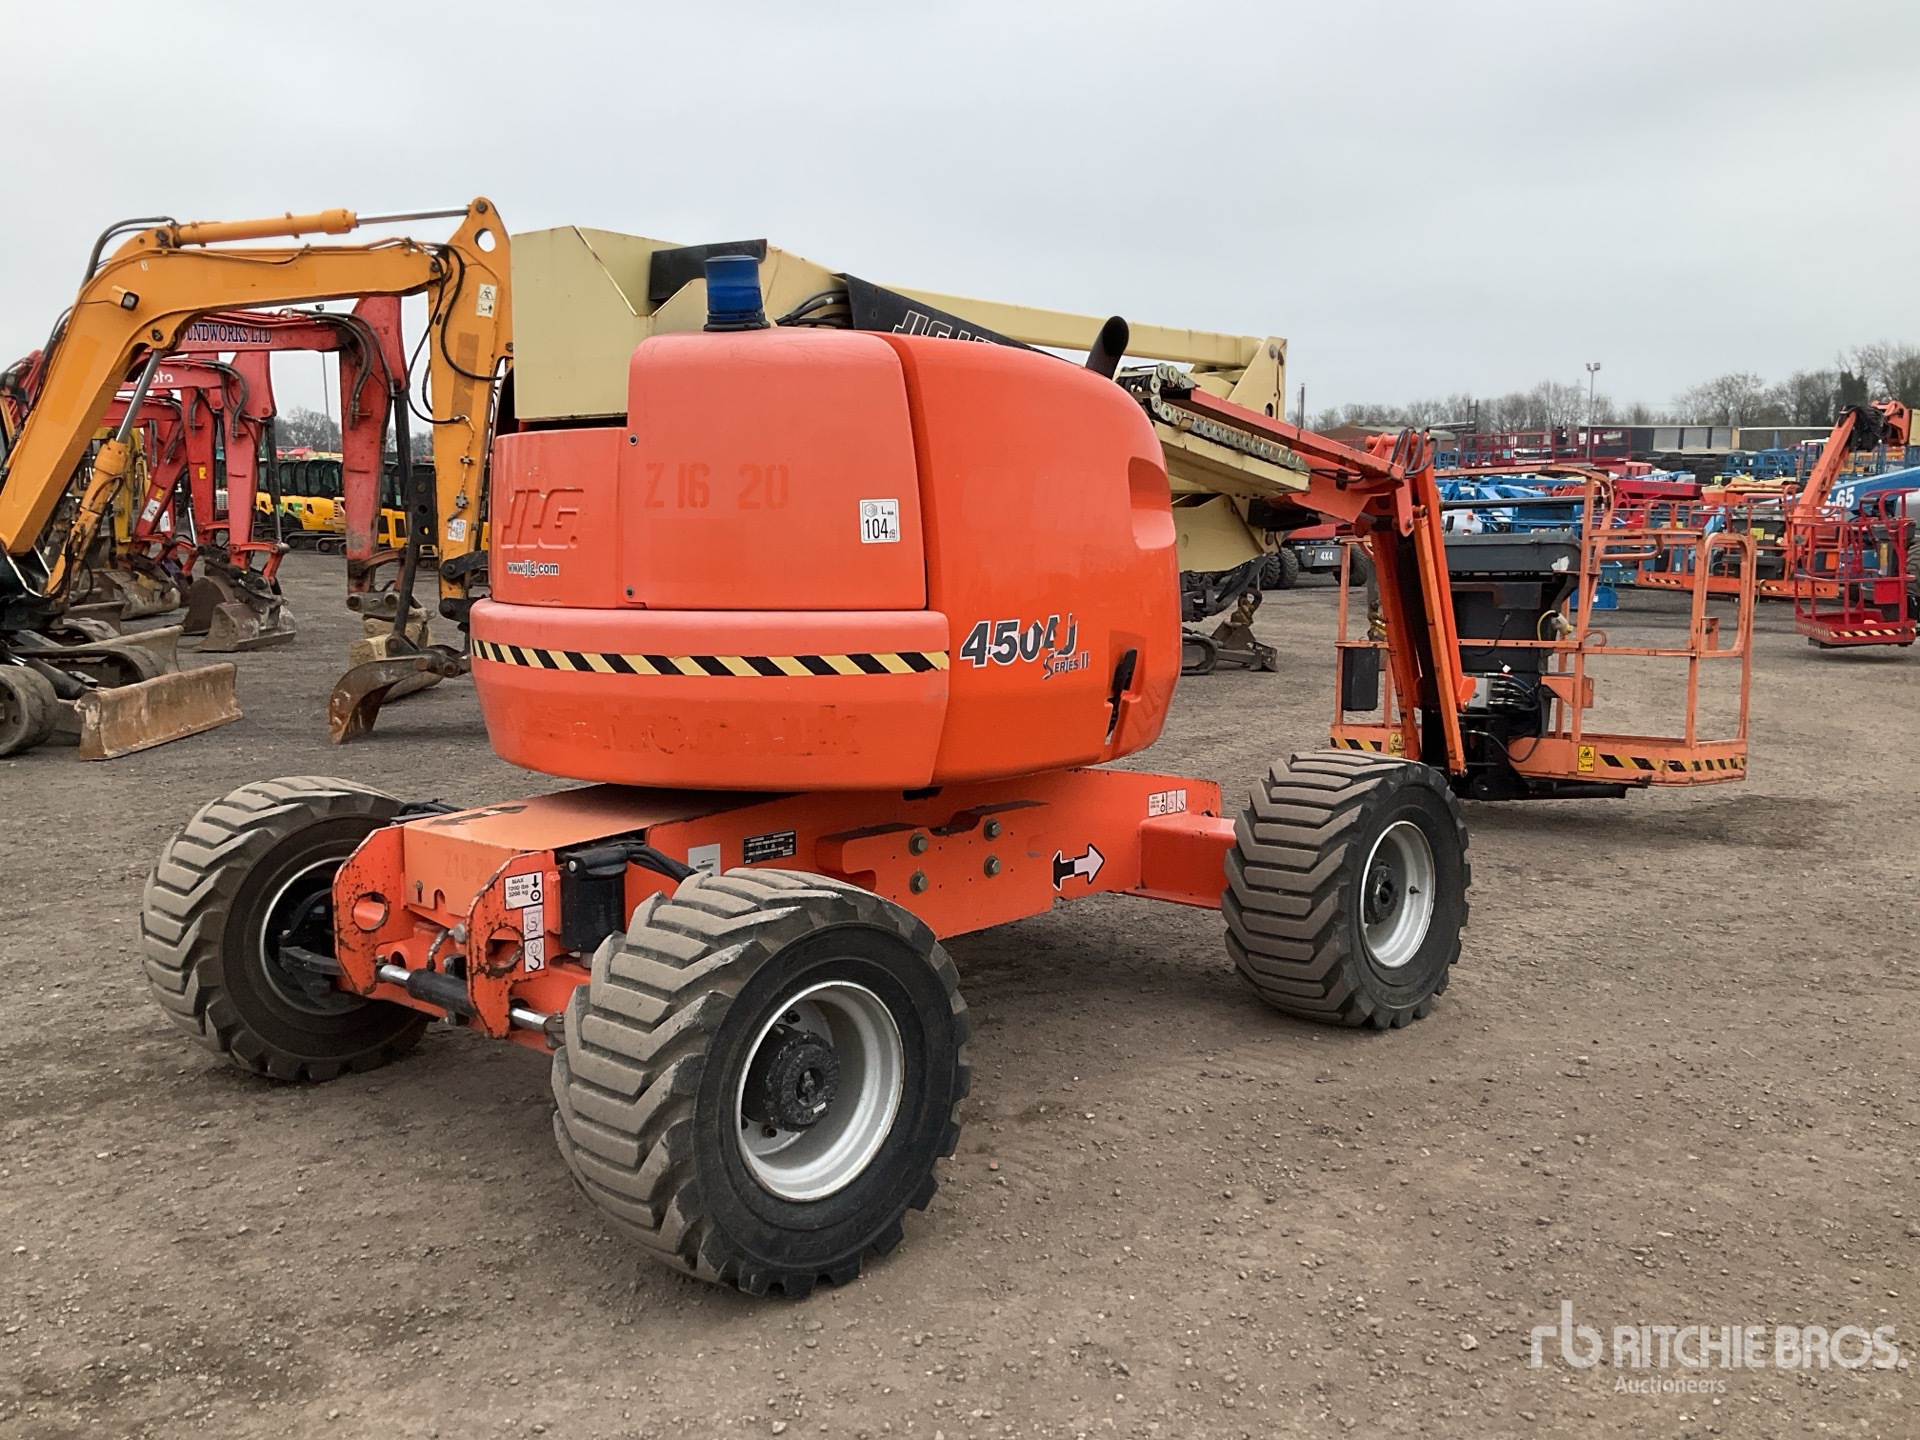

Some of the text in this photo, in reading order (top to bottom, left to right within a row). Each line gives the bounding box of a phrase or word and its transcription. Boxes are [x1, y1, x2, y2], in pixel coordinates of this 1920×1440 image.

[186, 323, 272, 344] UNDWORKS LTD
[737, 463, 790, 510] 20
[865, 518, 888, 539] 104
[1320, 551, 1333, 561] 4X4
[507, 560, 559, 577] www.jlg.com
